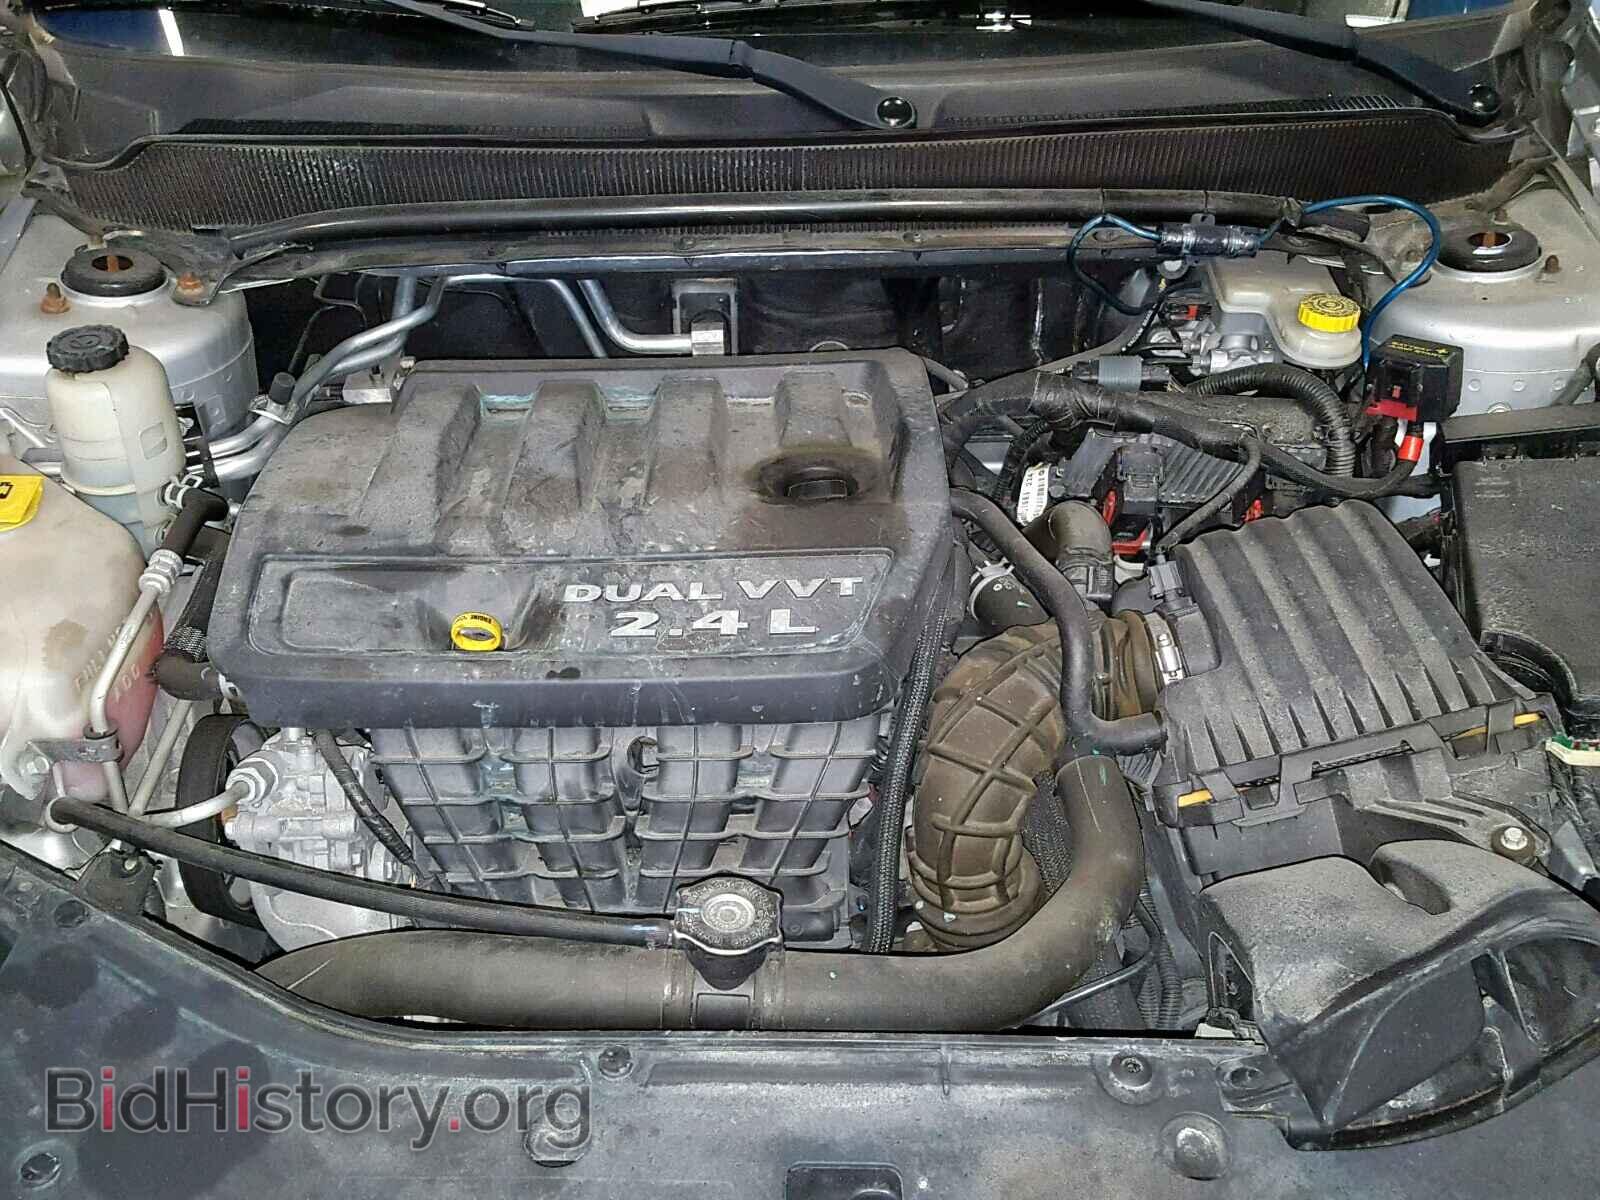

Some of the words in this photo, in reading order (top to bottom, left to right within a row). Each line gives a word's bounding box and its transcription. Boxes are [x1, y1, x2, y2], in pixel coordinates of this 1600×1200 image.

[562, 581, 724, 603] DUAL
[736, 576, 865, 601] VVT
[609, 609, 750, 637] 2.4
[769, 608, 818, 636] L
